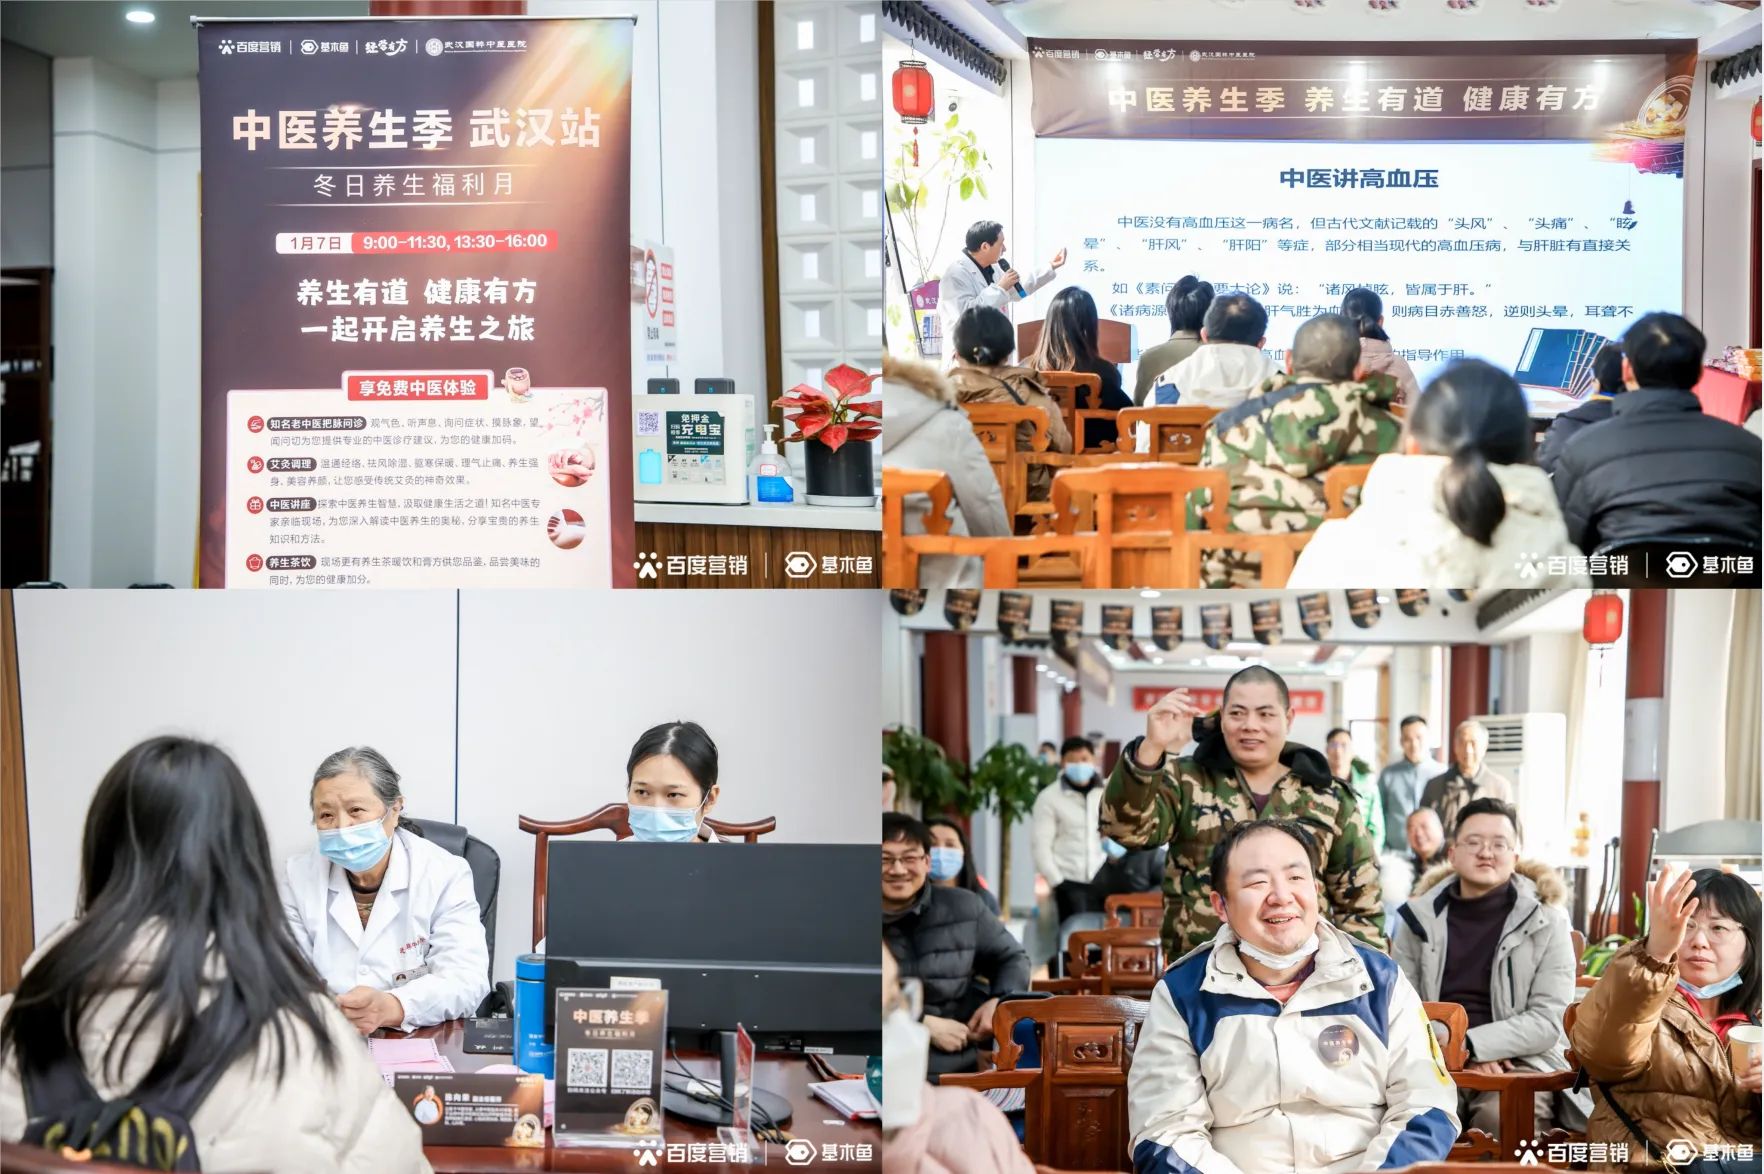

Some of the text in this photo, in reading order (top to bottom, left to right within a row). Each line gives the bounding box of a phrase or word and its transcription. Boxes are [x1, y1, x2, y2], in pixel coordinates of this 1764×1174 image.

[237, 41, 281, 53] 百度营销
[320, 41, 349, 53] 基木鱼
[364, 38, 408, 57] 经营有方
[1046, 49, 1080, 59] 百度营销
[1108, 83, 1602, 113] 中医养生季 养生有道 健康有方
[232, 107, 601, 151] 中医养生季 武汉站
[313, 172, 514, 197] 冬日养生福利月
[1279, 167, 1440, 189] 中医讲高血压
[289, 236, 342, 251] 1月7日
[1083, 259, 1105, 273] 系。
[297, 277, 538, 305] 养生有道 健康有方
[300, 314, 536, 343] 一起开启养生之旅
[358, 379, 477, 398] 享免费中医体验
[270, 418, 364, 430] 知名老中医把脉问诊
[681, 413, 710, 424] 免押金
[681, 423, 722, 436] 充电宝
[270, 458, 312, 470] 艾灸调理
[269, 499, 311, 510] 中医讲座
[269, 534, 326, 545] 知识和方法。
[269, 557, 312, 569] 养生茶饮
